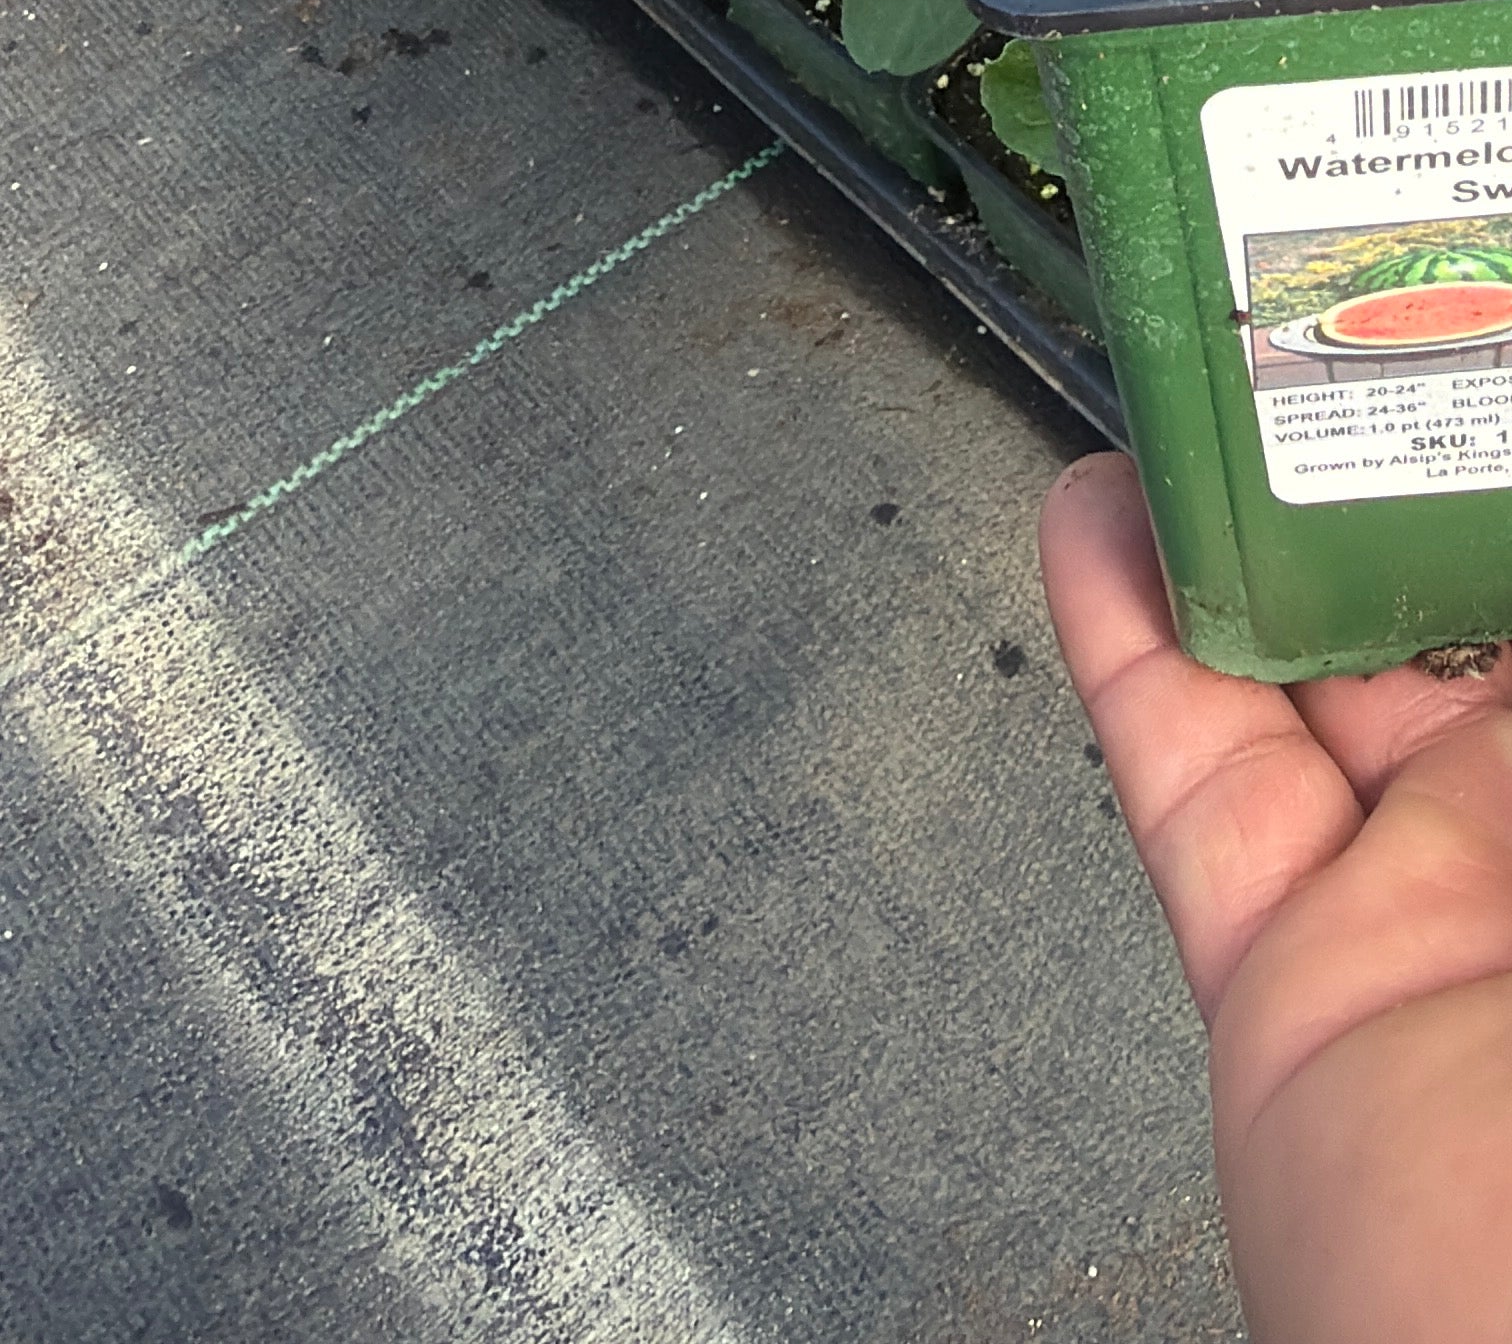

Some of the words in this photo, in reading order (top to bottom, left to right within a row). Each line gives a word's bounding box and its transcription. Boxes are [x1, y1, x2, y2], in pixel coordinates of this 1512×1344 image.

[1272, 389, 1354, 408] HEIGHT:
[1274, 408, 1362, 426] SPREAD:
[1275, 425, 1365, 444] VOLUME:
[1368, 422, 1396, 435] 1.0
[1401, 419, 1420, 434] pt
[1425, 415, 1464, 431] (473
[1471, 413, 1501, 426] ml)
[1411, 433, 1477, 452] SKU:
[1294, 460, 1356, 475] Grown
[1362, 457, 1385, 469] by
[1426, 468, 1448, 479] La
[1455, 461, 1510, 476] Porte,
